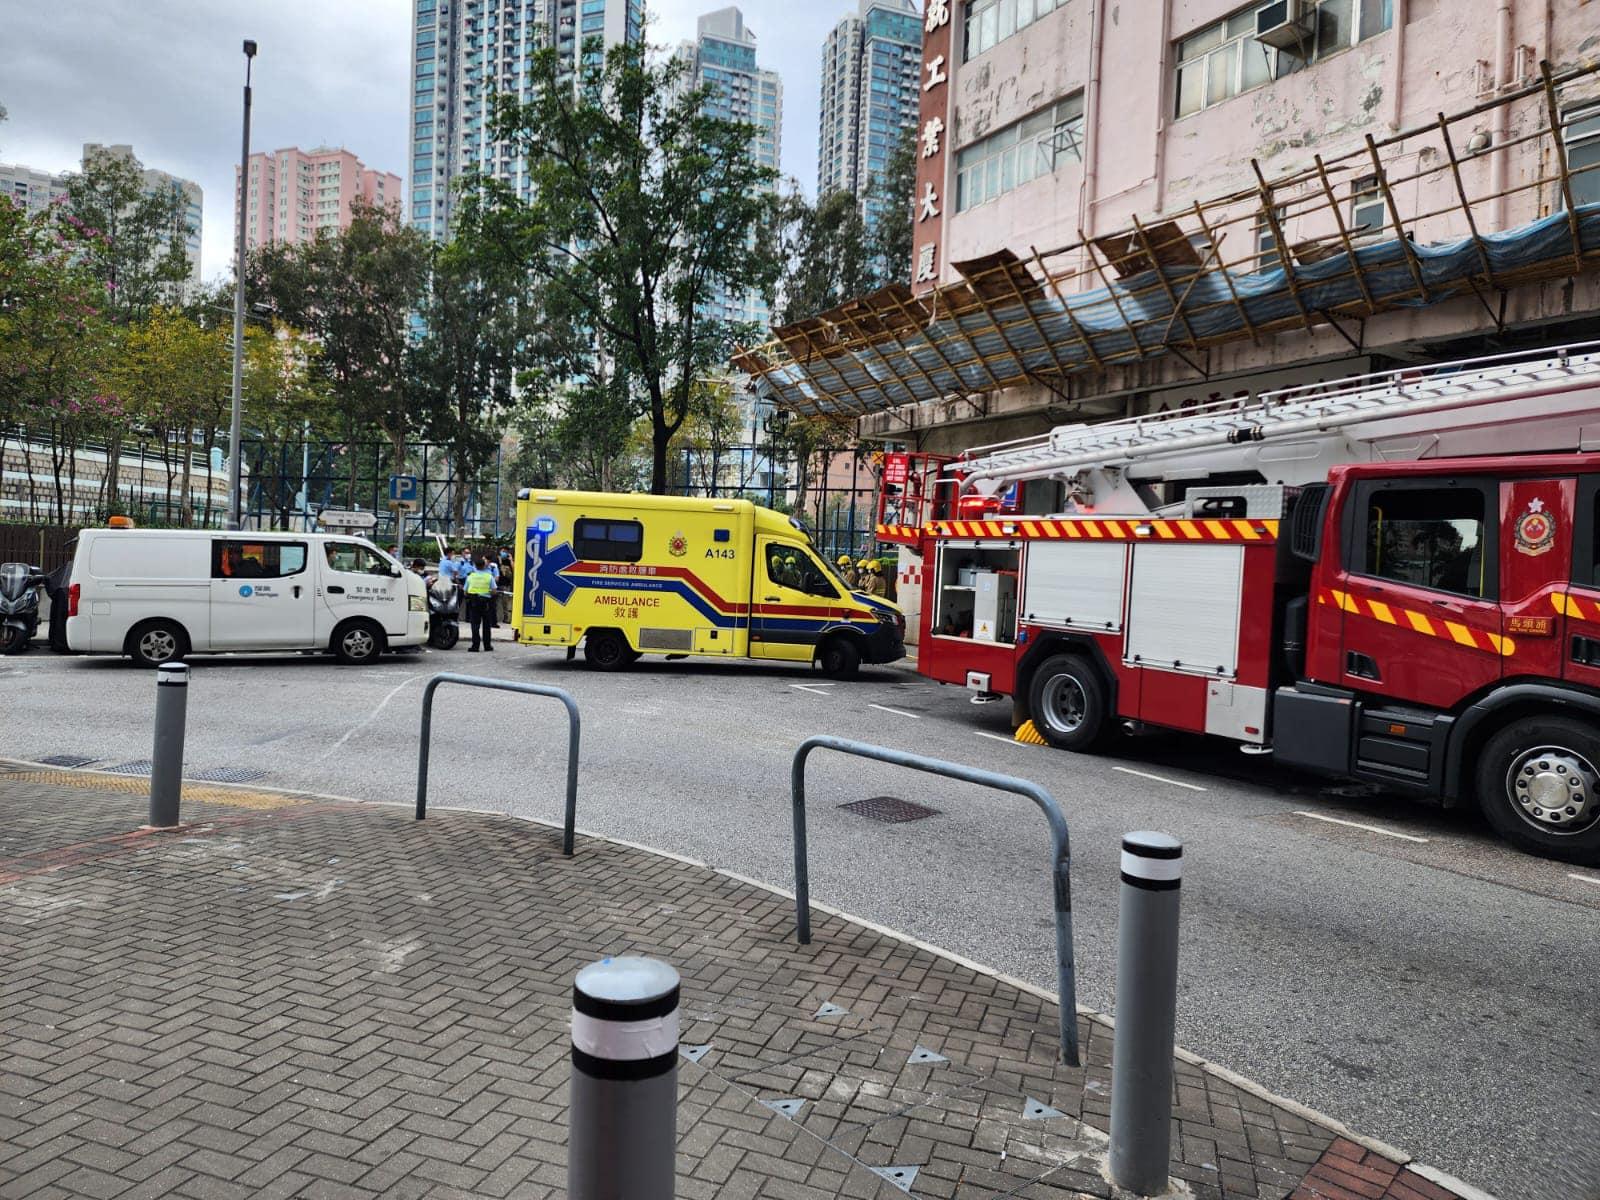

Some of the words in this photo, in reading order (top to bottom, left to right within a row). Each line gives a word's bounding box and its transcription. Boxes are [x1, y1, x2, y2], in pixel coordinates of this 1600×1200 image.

[396, 479, 412, 497] P
[705, 549, 735, 559] A143
[346, 593, 375, 602] Emergency
[594, 595, 660, 607] AMBULANCE
[613, 607, 639, 619] 救護
